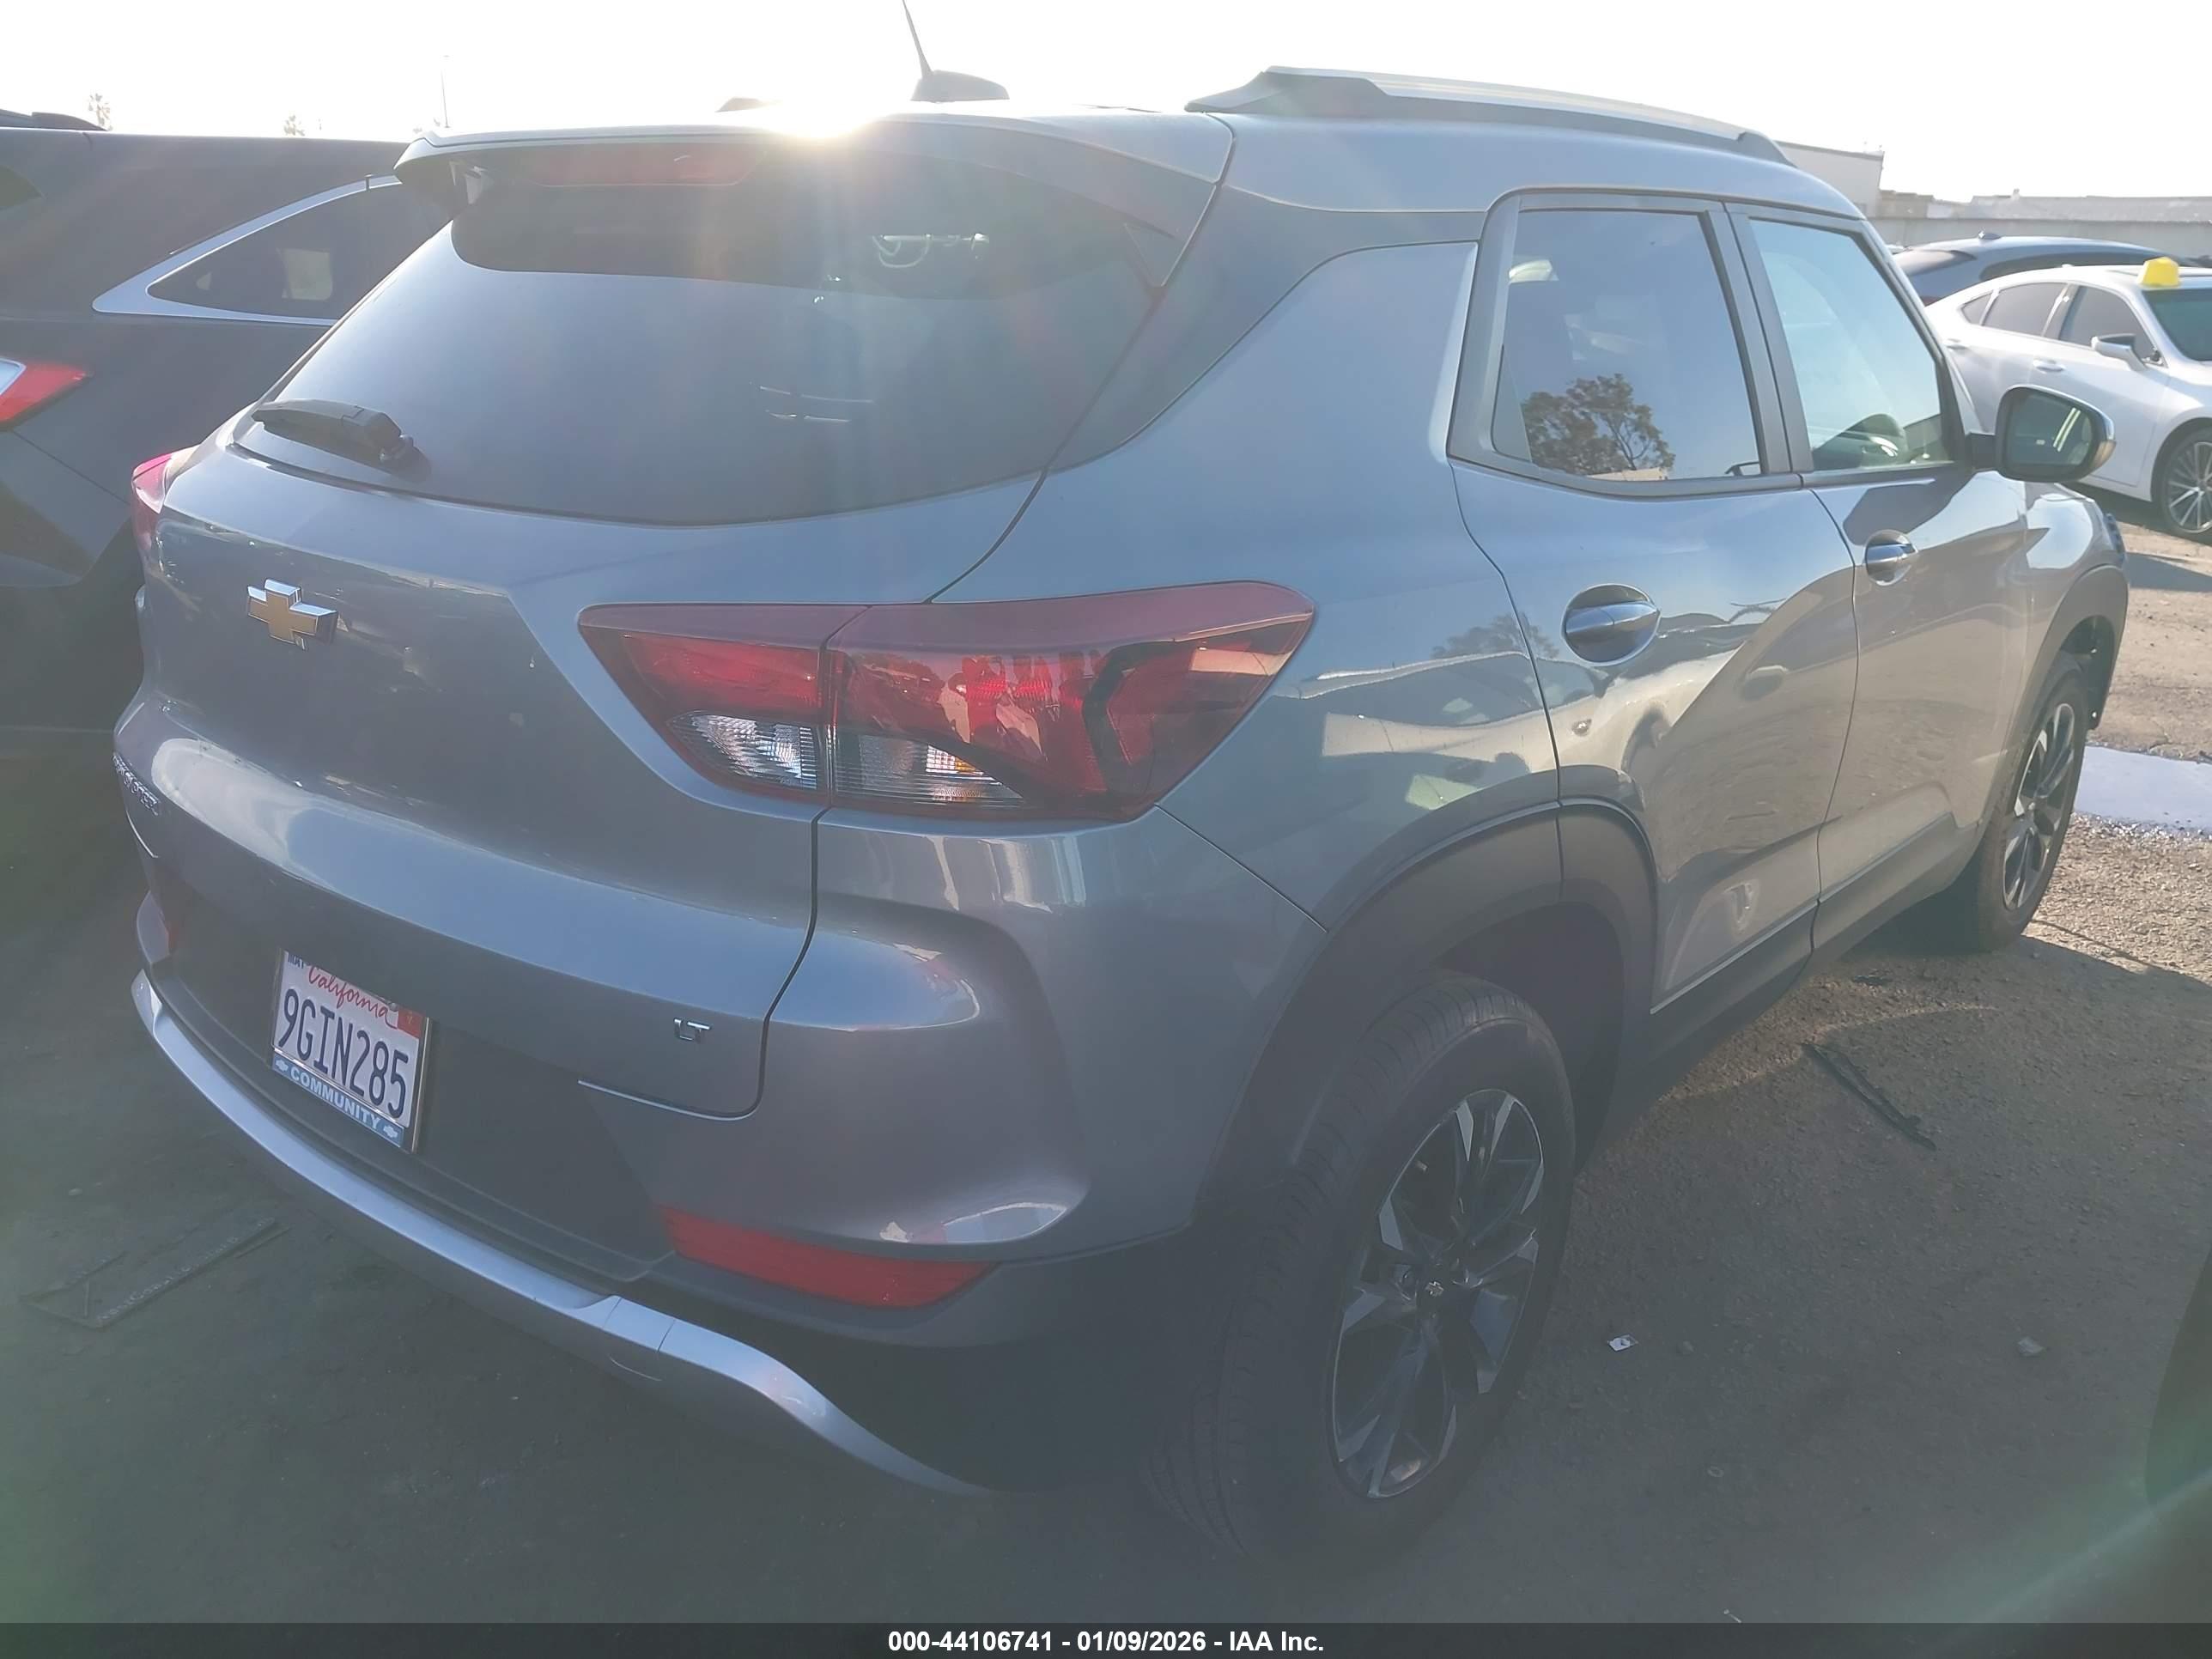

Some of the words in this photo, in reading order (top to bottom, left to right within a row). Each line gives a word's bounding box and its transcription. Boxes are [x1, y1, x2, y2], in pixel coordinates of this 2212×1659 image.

[308, 965, 398, 1030] California
[278, 988, 409, 1119] 9GIN285
[674, 1018, 710, 1042] LT
[290, 1067, 384, 1130] COMMUNITY
